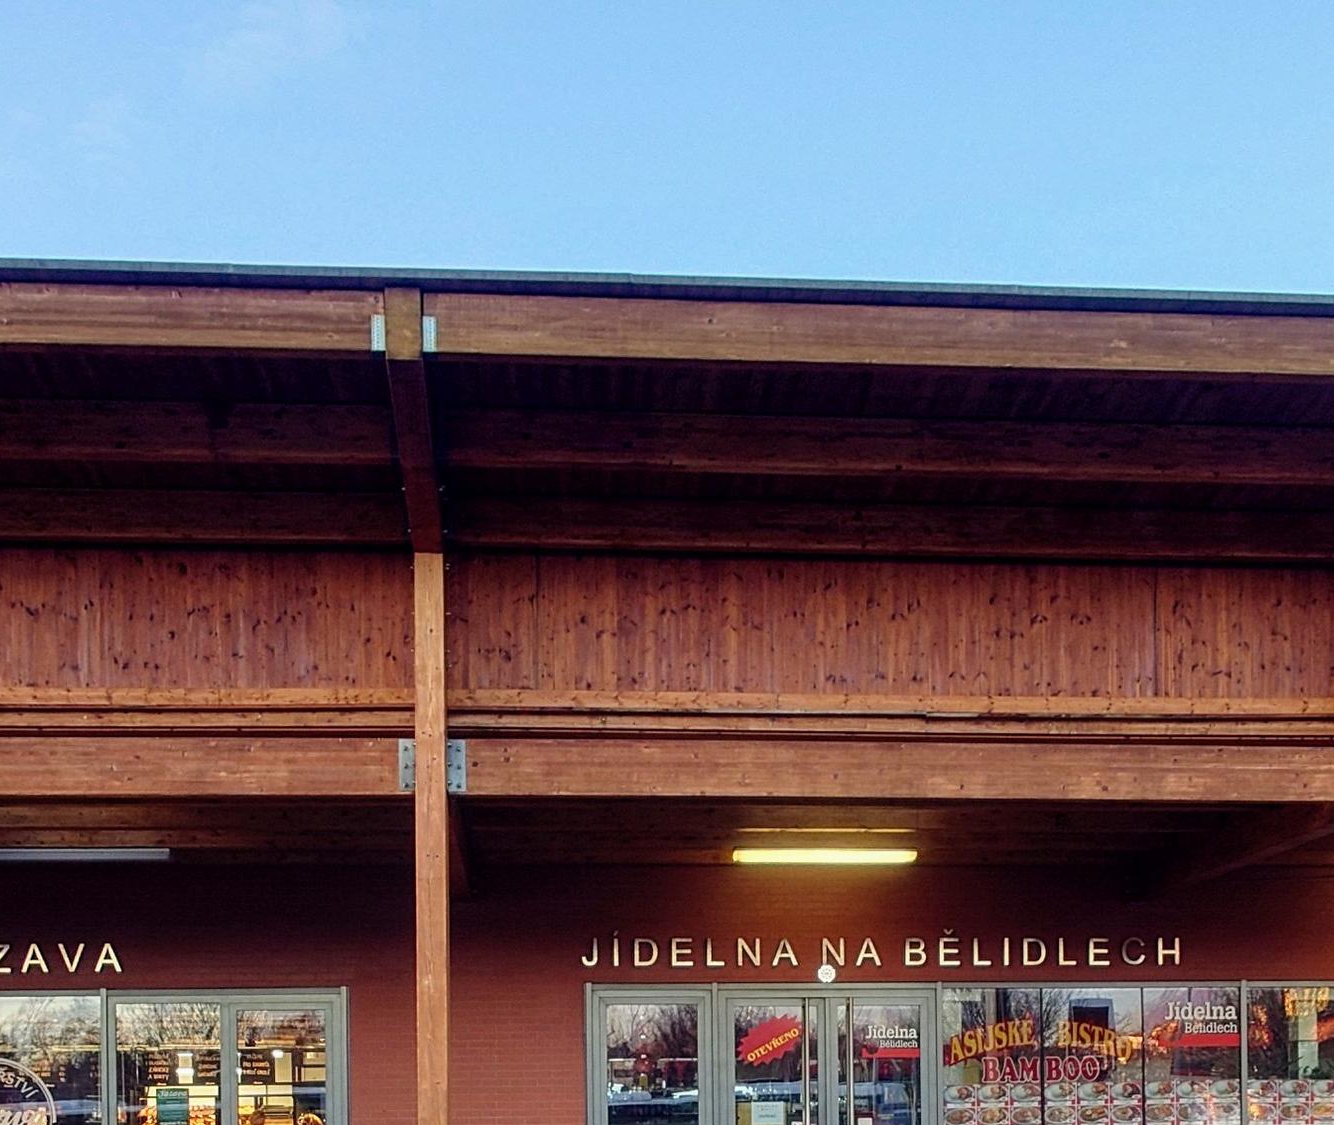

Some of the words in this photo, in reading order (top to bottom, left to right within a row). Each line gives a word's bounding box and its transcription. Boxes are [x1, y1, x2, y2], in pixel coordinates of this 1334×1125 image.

[581, 930, 799, 967] JÍDELNA
[822, 937, 882, 967] NA
[904, 928, 1181, 967] BĚLIDLECH
[1164, 1001, 1238, 1020] Jídelna
[865, 1025, 919, 1040] Jídelna
[948, 1011, 1037, 1065] ASIJSKÉ
[1057, 1019, 1134, 1064] BISTRO
[1184, 1022, 1238, 1034] Bělidlech
[747, 1027, 800, 1062] OTEVŘENO
